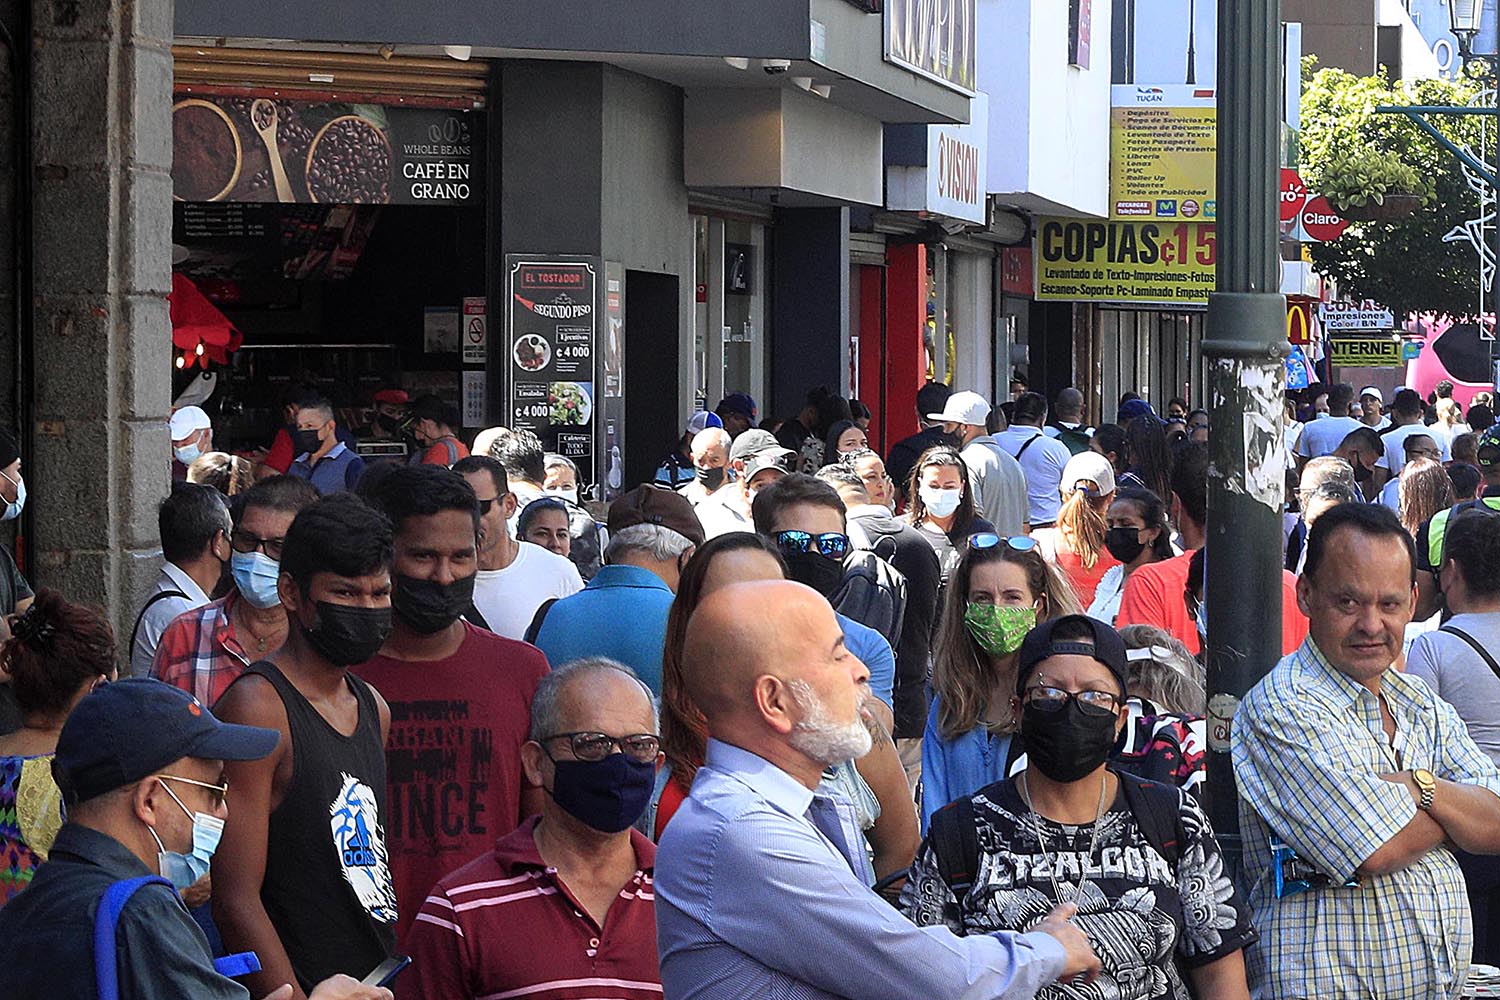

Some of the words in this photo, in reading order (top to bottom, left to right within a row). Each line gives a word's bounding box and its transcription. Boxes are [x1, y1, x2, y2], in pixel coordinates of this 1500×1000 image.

[404, 144, 438, 155] WHOLE
[440, 145, 471, 155] BEANS
[403, 160, 445, 179] CAFÉ
[448, 163, 470, 180] EN
[946, 136, 979, 206] VISION
[411, 183, 470, 200] GRANO
[1303, 212, 1340, 225] Claro
[1042, 221, 1159, 264] COPIAS
[525, 273, 535, 282] EL
[539, 273, 581, 283] TOSTADOR
[1045, 267, 1090, 280] Levantado
[1092, 268, 1104, 279] de
[1041, 283, 1114, 297] Escaneo-Soporte
[1116, 285, 1173, 298] Pc-Laminado
[534, 304, 572, 319] SEGUNDO
[573, 304, 591, 318] PISO
[1323, 312, 1386, 322] Impresiones
